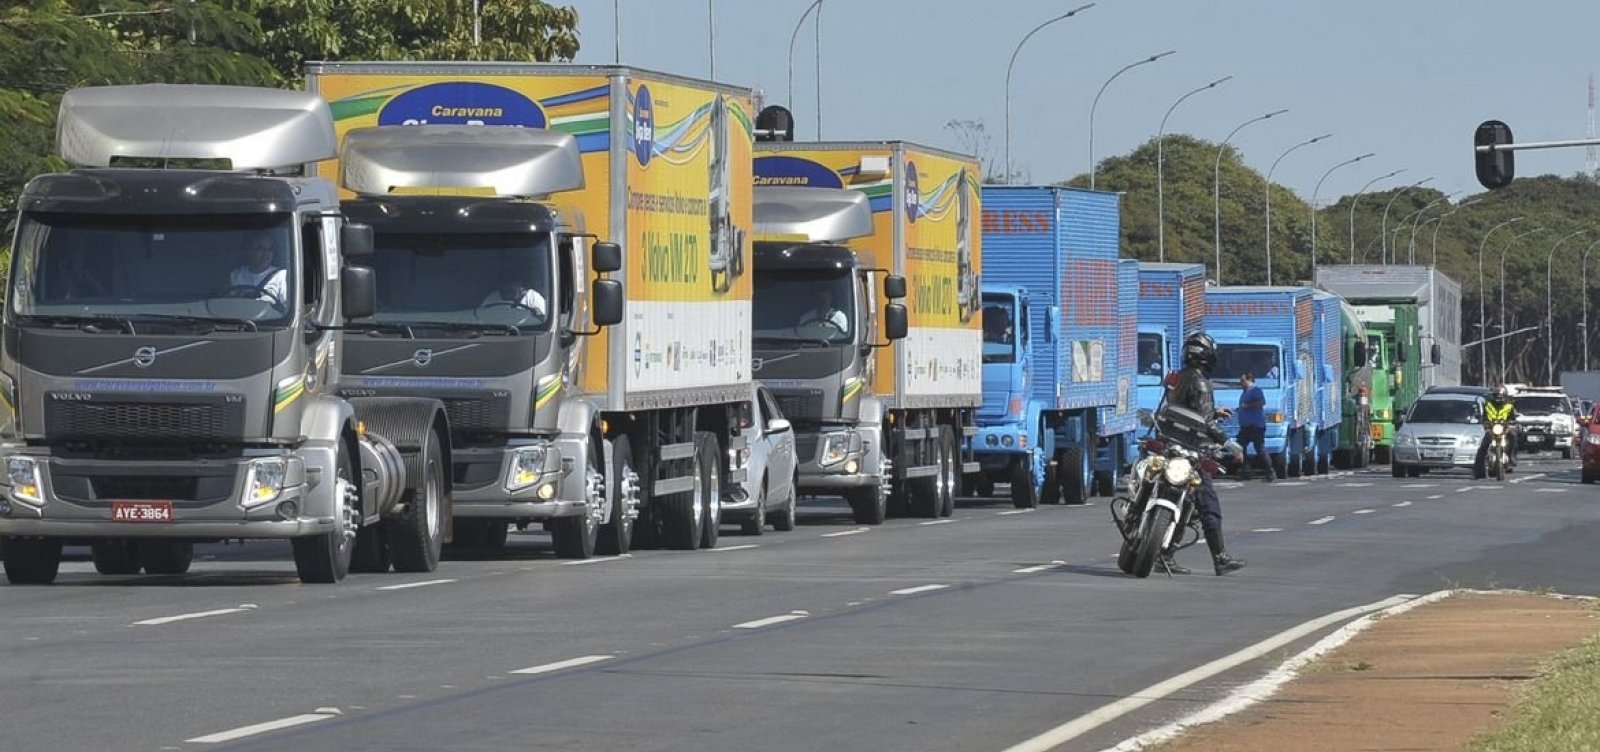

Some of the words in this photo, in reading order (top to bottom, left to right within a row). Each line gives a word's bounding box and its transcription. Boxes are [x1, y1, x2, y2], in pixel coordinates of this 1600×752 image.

[431, 105, 503, 117] Caravana
[752, 175, 809, 185] Caravana
[51, 392, 92, 400] VOLVO
